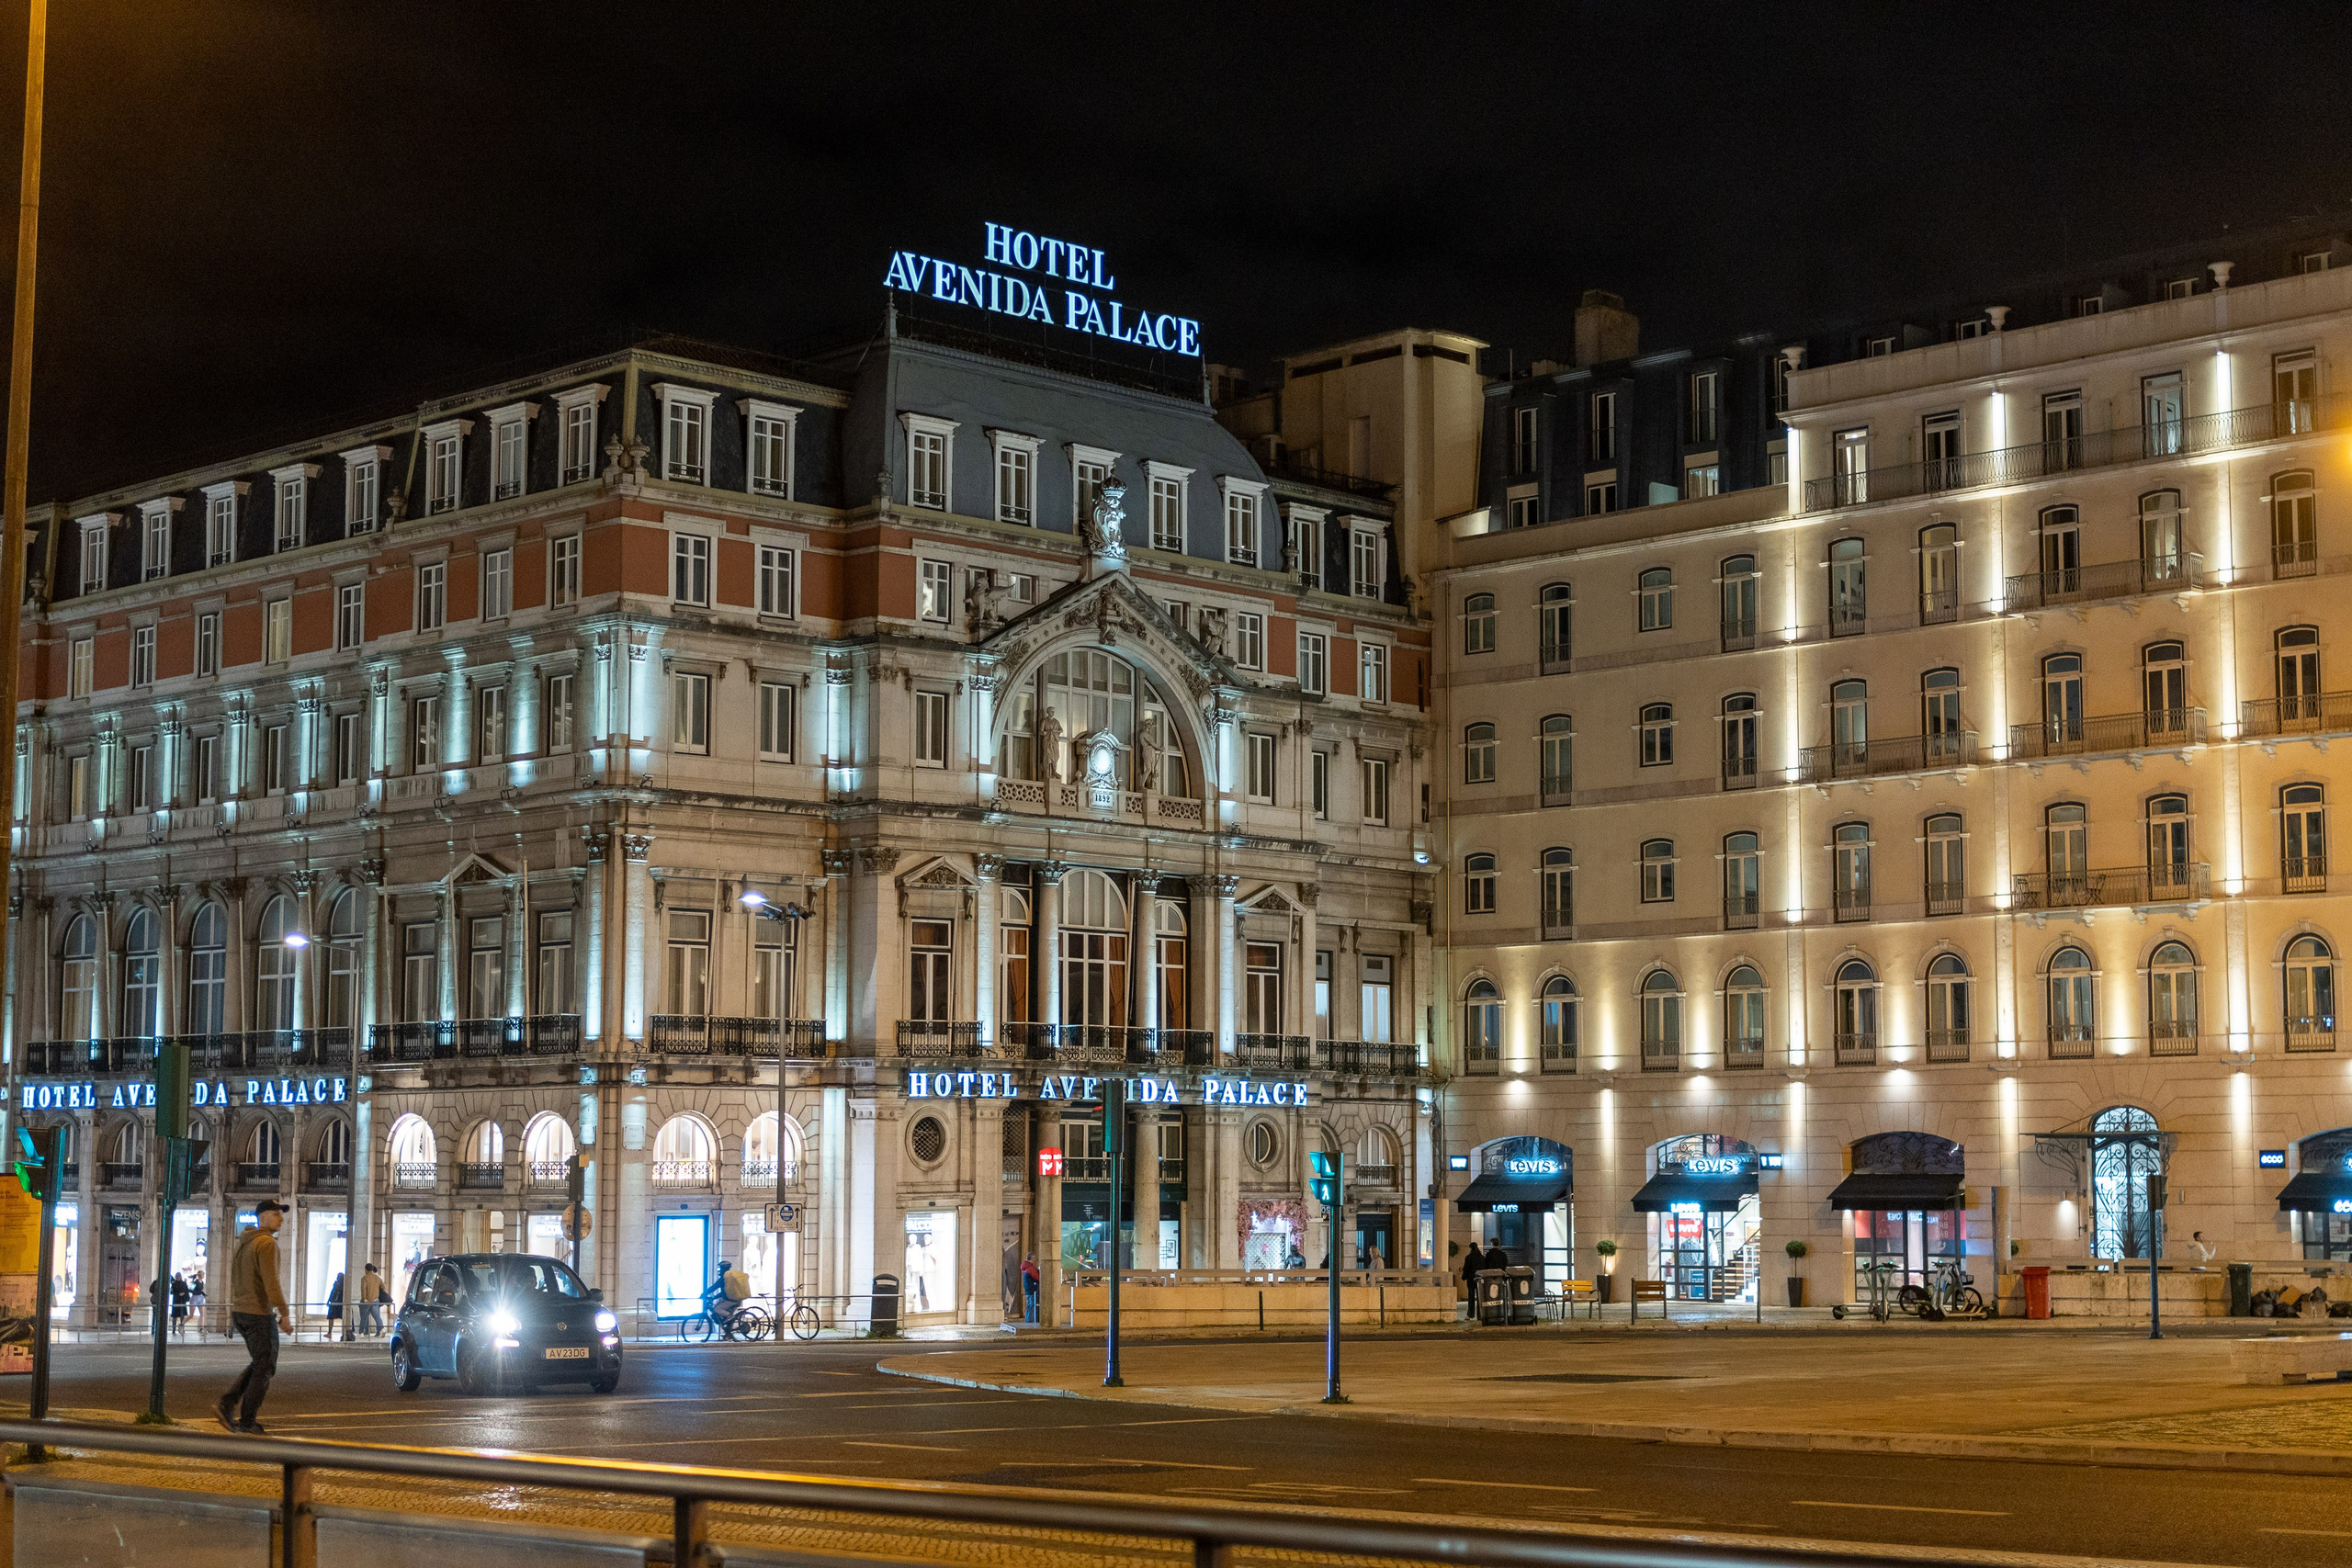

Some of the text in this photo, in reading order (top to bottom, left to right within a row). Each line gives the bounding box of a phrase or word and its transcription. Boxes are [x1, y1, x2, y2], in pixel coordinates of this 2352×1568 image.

[984, 221, 1114, 290] HOTEL
[883, 251, 1200, 357] AVENIDA PALACE
[1095, 794, 1111, 804] 1892
[22, 1077, 346, 1109] HOTEL AVEDA PALACE
[906, 1072, 1308, 1107] HOTEL AVEIDA PALACE
[2261, 1155, 2283, 1164] ecco
[111, 1210, 141, 1221] TEZENIS
